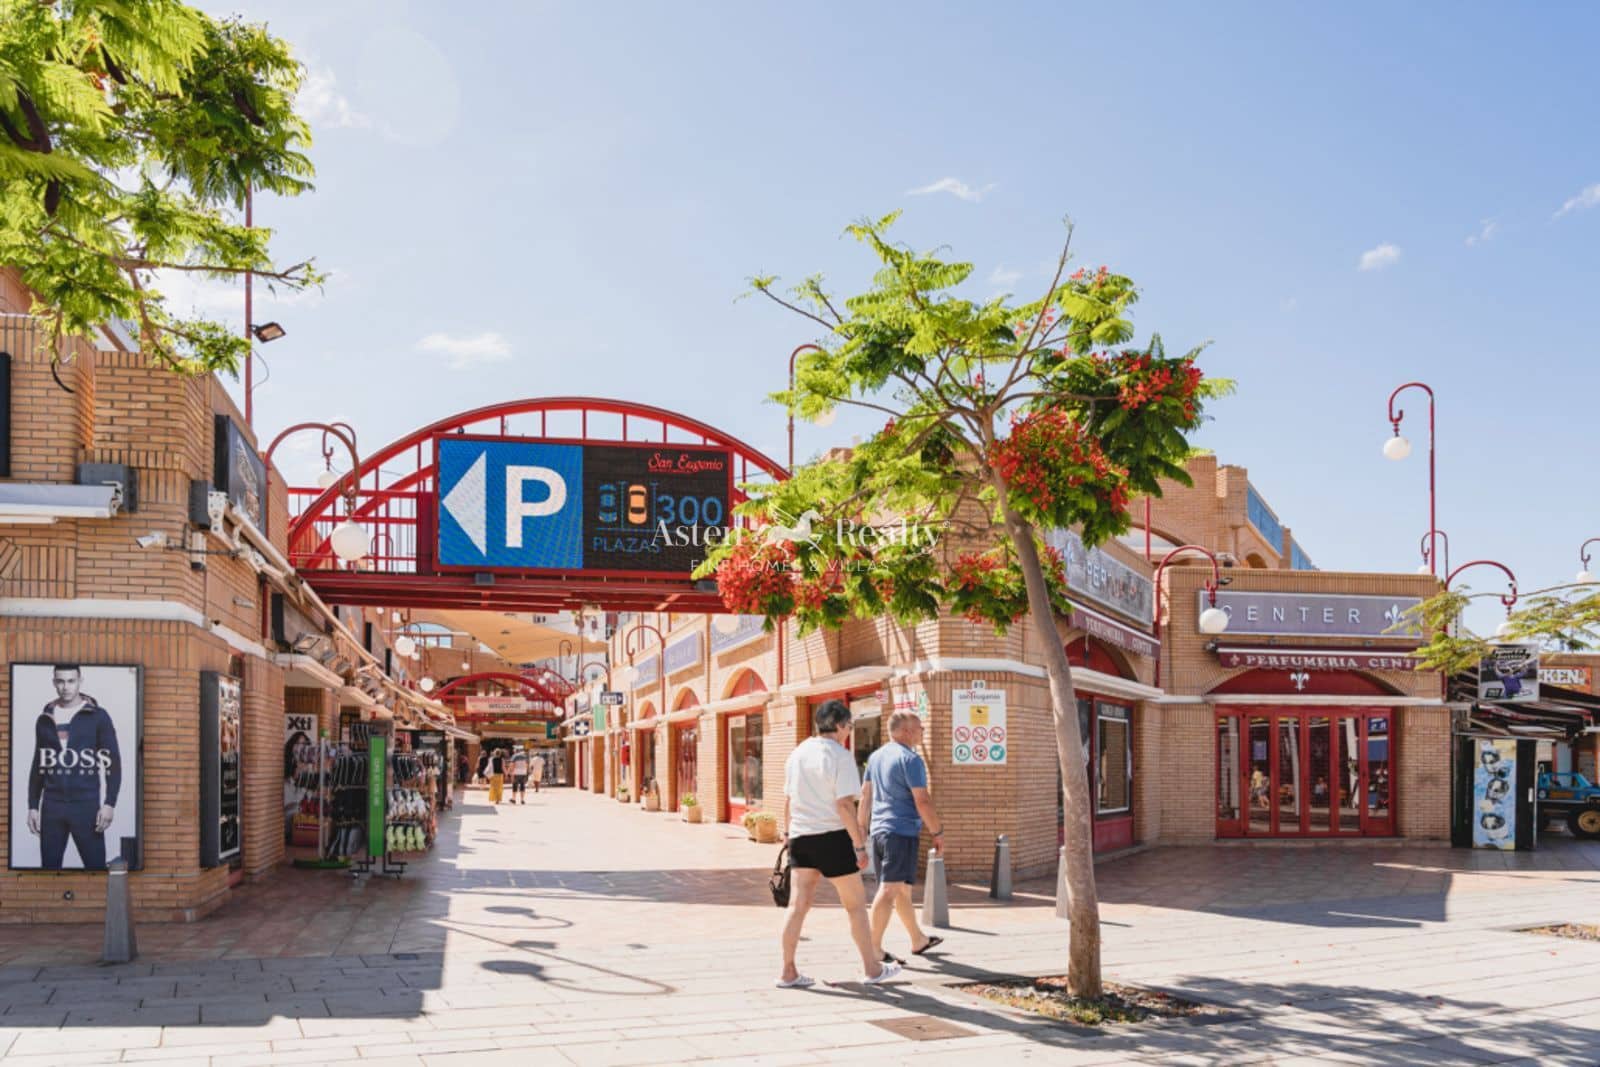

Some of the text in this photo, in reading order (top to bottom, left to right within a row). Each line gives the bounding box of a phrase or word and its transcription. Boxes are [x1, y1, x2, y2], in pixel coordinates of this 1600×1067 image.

[506, 465, 567, 548] P
[657, 495, 723, 526] 300
[1246, 655, 1359, 668] PERFUMERIA
[287, 716, 313, 731] Xti
[39, 747, 113, 769] BOSS
